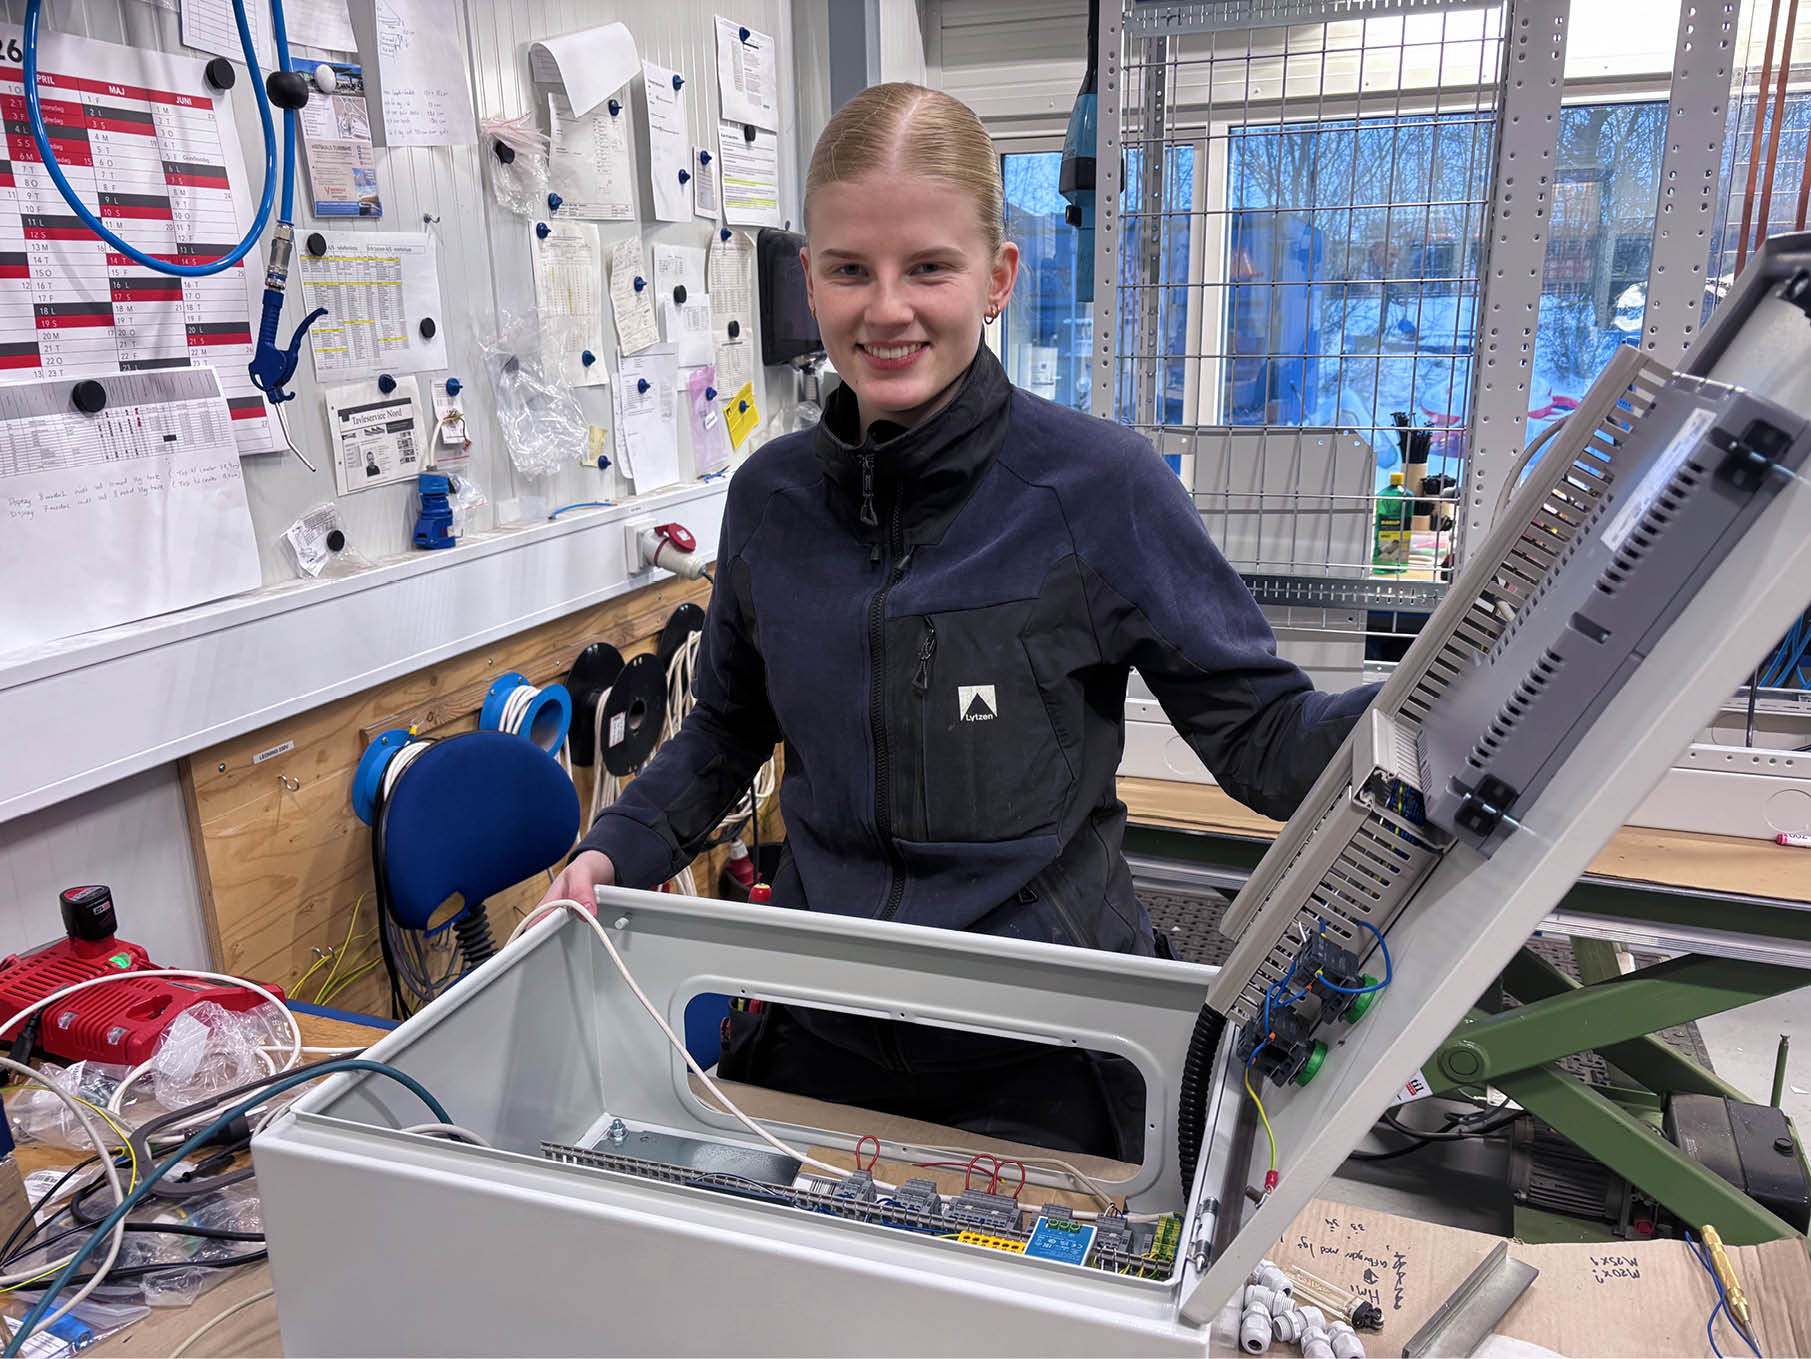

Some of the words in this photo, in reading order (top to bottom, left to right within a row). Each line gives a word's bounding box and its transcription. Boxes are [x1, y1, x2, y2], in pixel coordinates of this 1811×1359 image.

[36, 74, 56, 85] PRIL
[108, 86, 125, 95] MAJ
[175, 95, 192, 105] JUNI
[84, 158, 92, 166] 15
[27, 218, 36, 226] 11
[166, 223, 174, 231] 20
[30, 231, 38, 239] 12
[40, 307, 48, 315] 18
[41, 320, 50, 328] 19
[353, 412, 385, 424] Tavleservice
[386, 408, 402, 417] Nord
[965, 713, 994, 722] Lytzen
